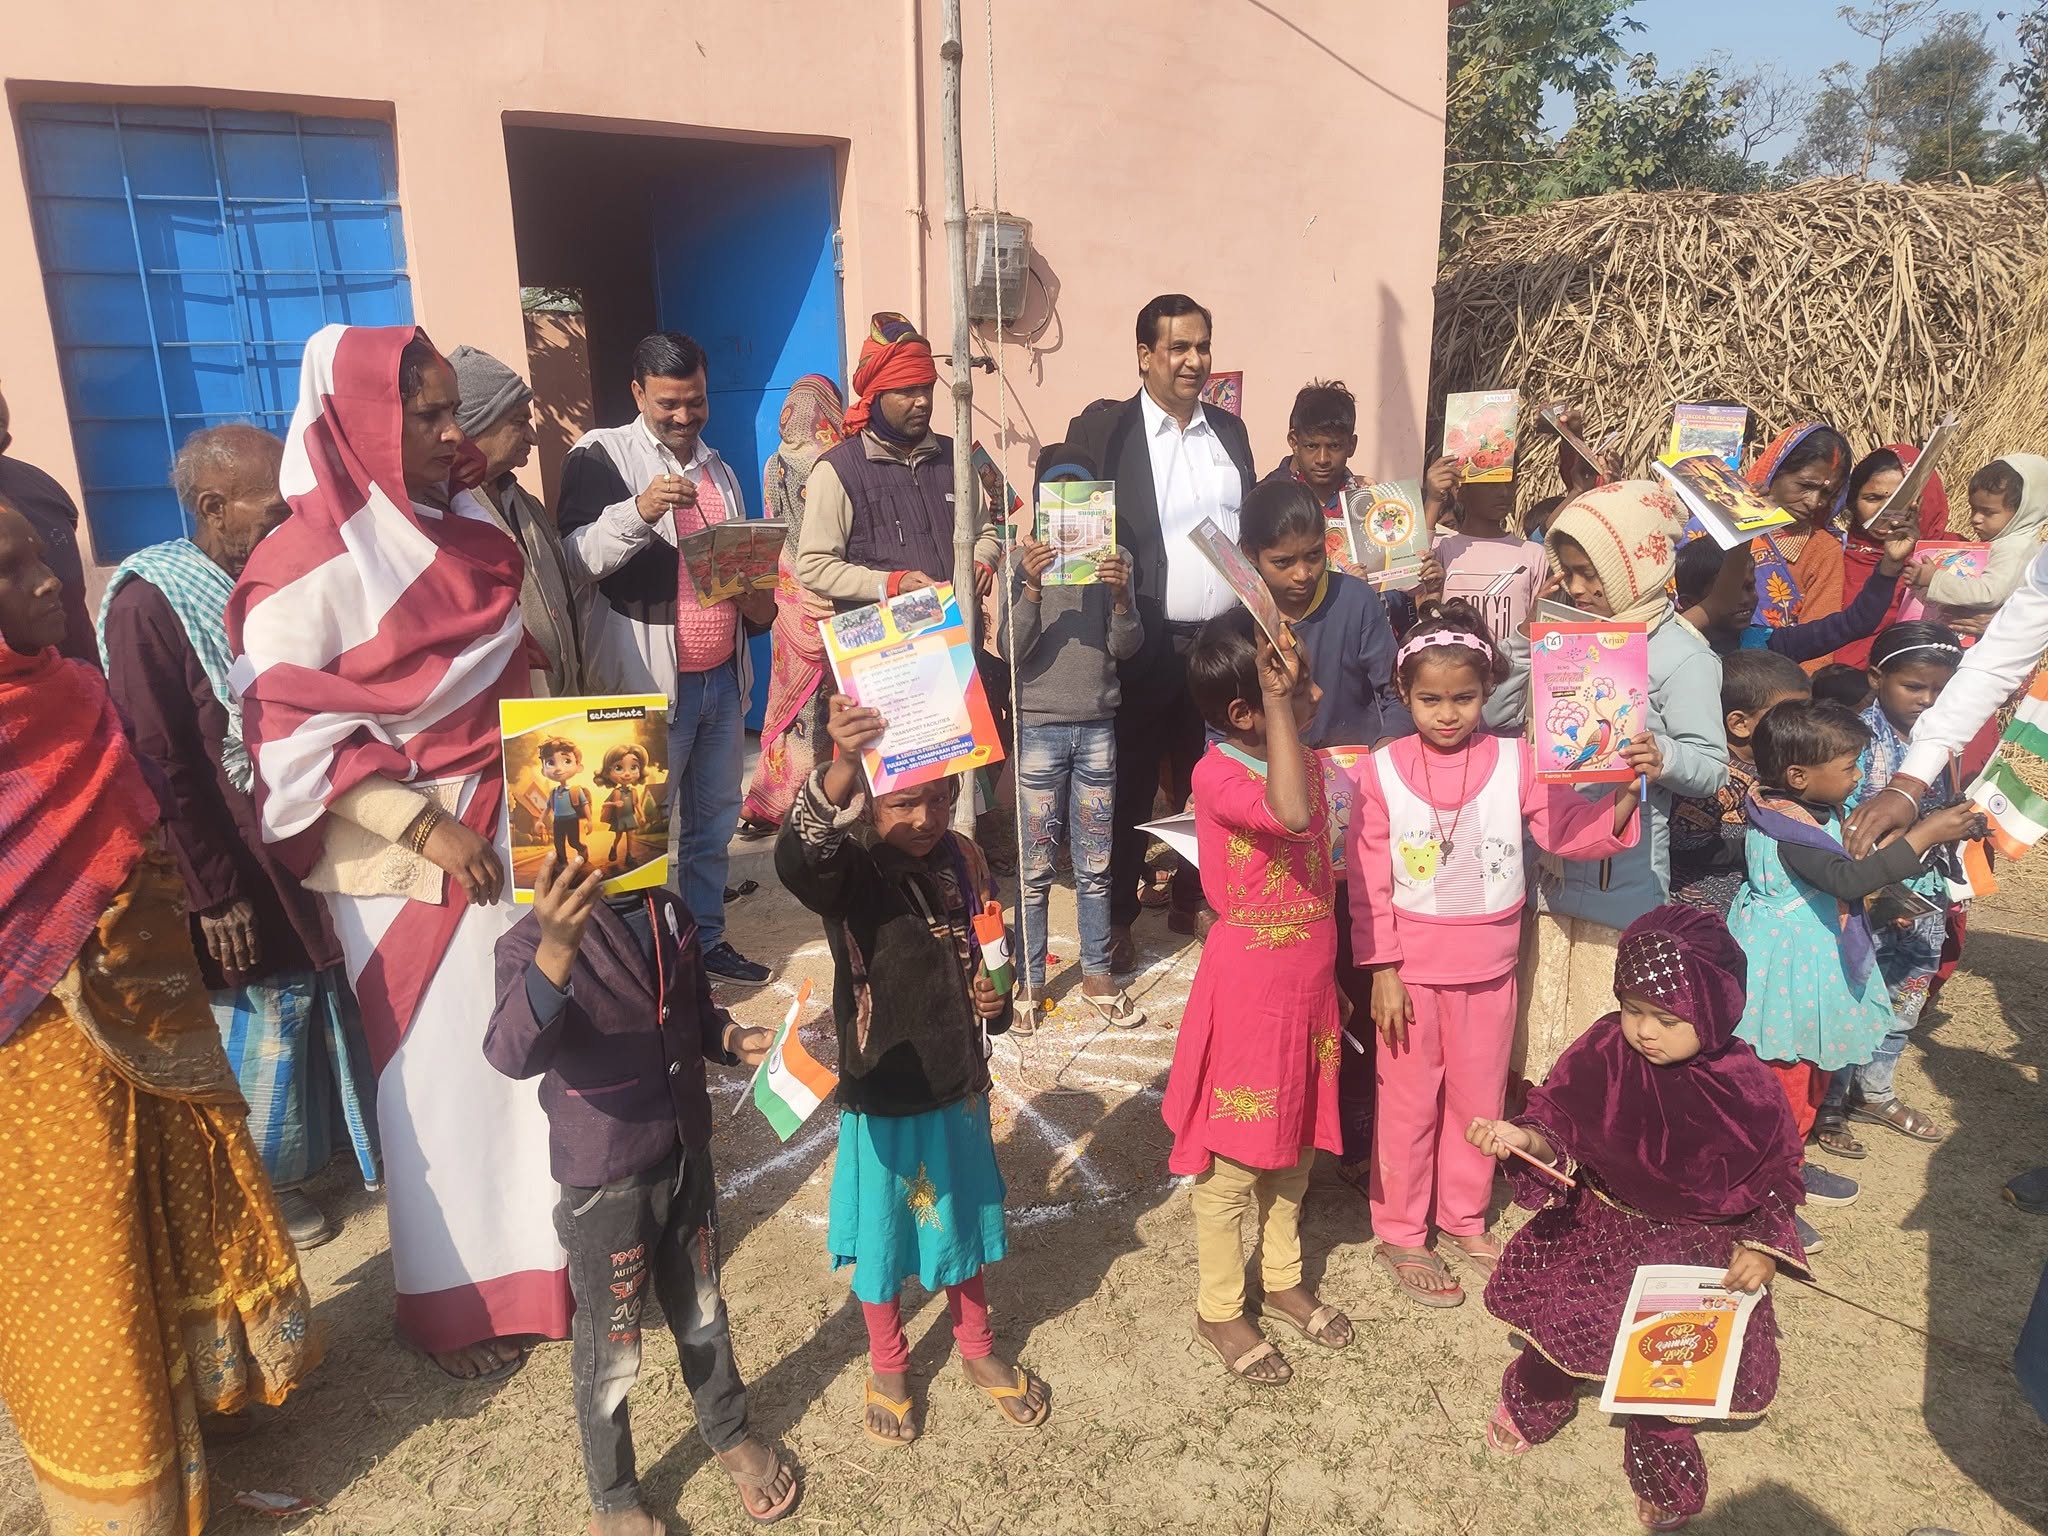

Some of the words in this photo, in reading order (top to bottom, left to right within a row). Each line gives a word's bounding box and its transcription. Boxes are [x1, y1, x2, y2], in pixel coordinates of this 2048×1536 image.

[1462, 594, 1512, 645] KYO
[1601, 636, 1625, 645] Arjun
[589, 709, 643, 720] schoolmate
[1660, 1346, 1695, 1363] Best
